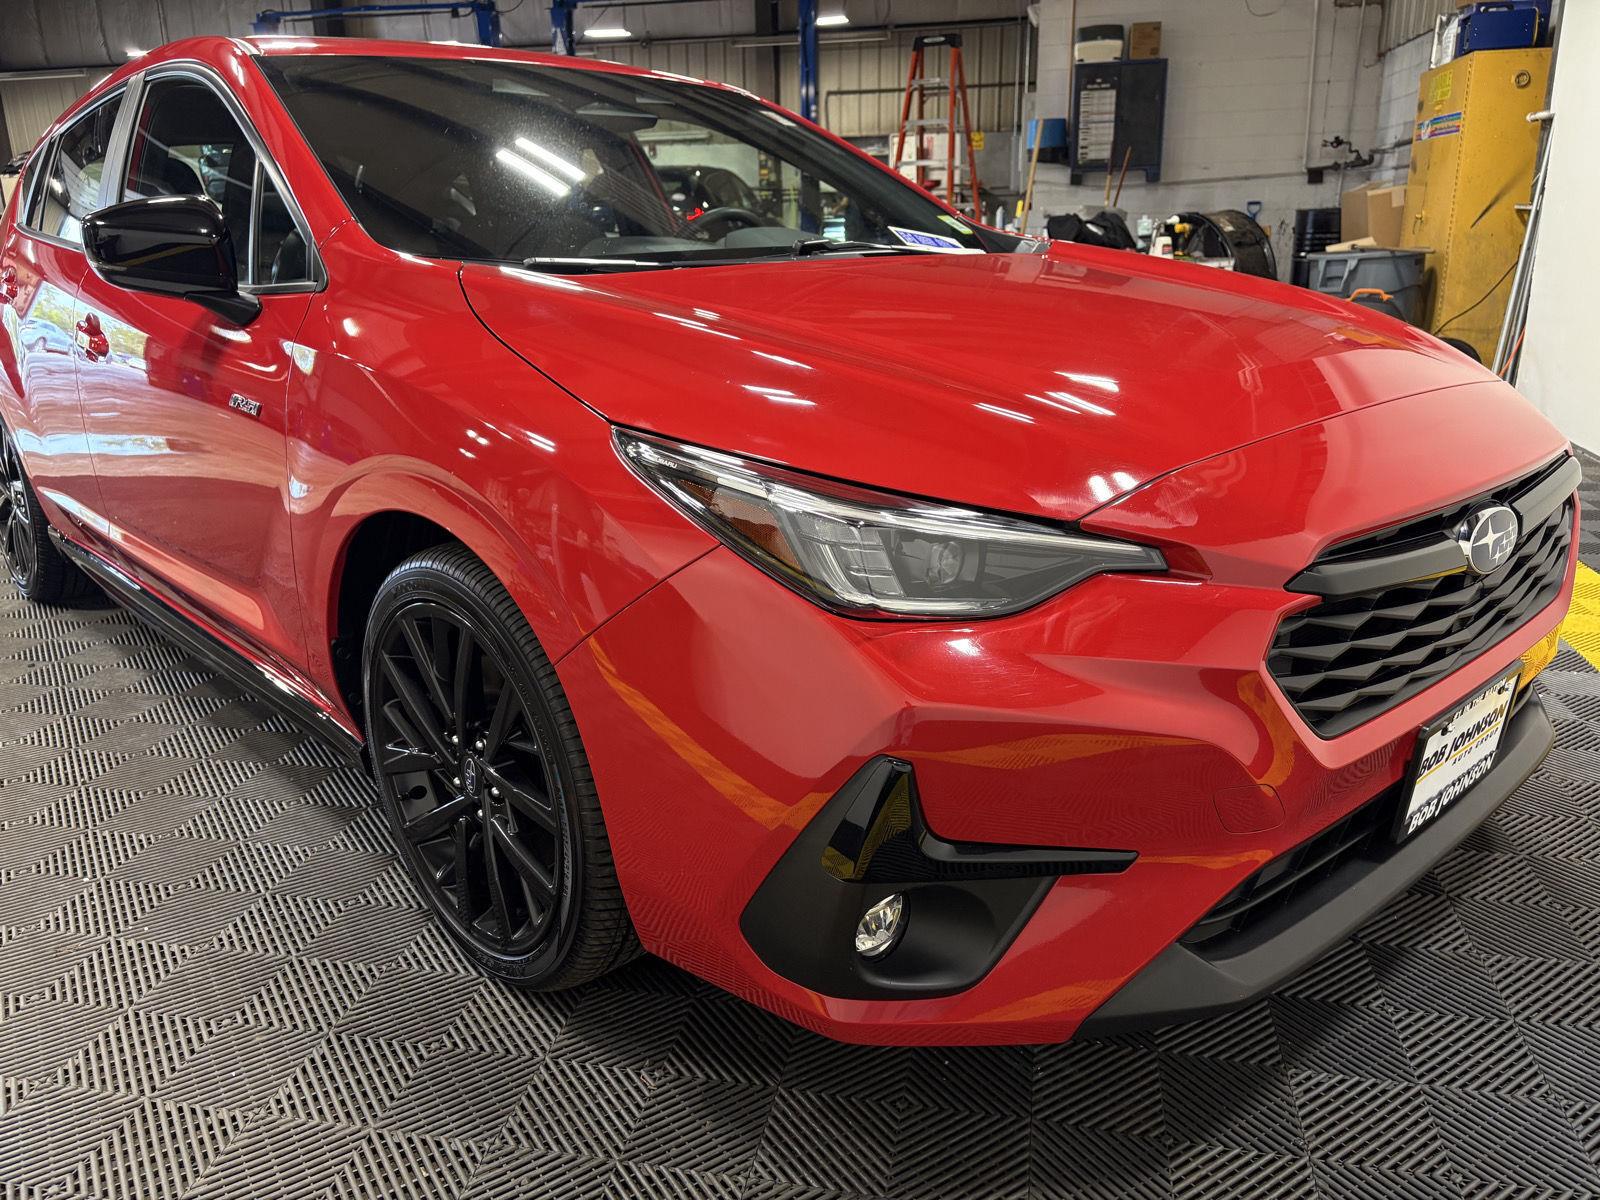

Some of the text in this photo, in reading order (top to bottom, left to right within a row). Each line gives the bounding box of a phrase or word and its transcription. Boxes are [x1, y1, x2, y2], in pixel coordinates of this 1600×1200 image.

[1418, 701, 1508, 777] BOB JOHNSON
[1407, 752, 1495, 835] BOB JOHNSON
